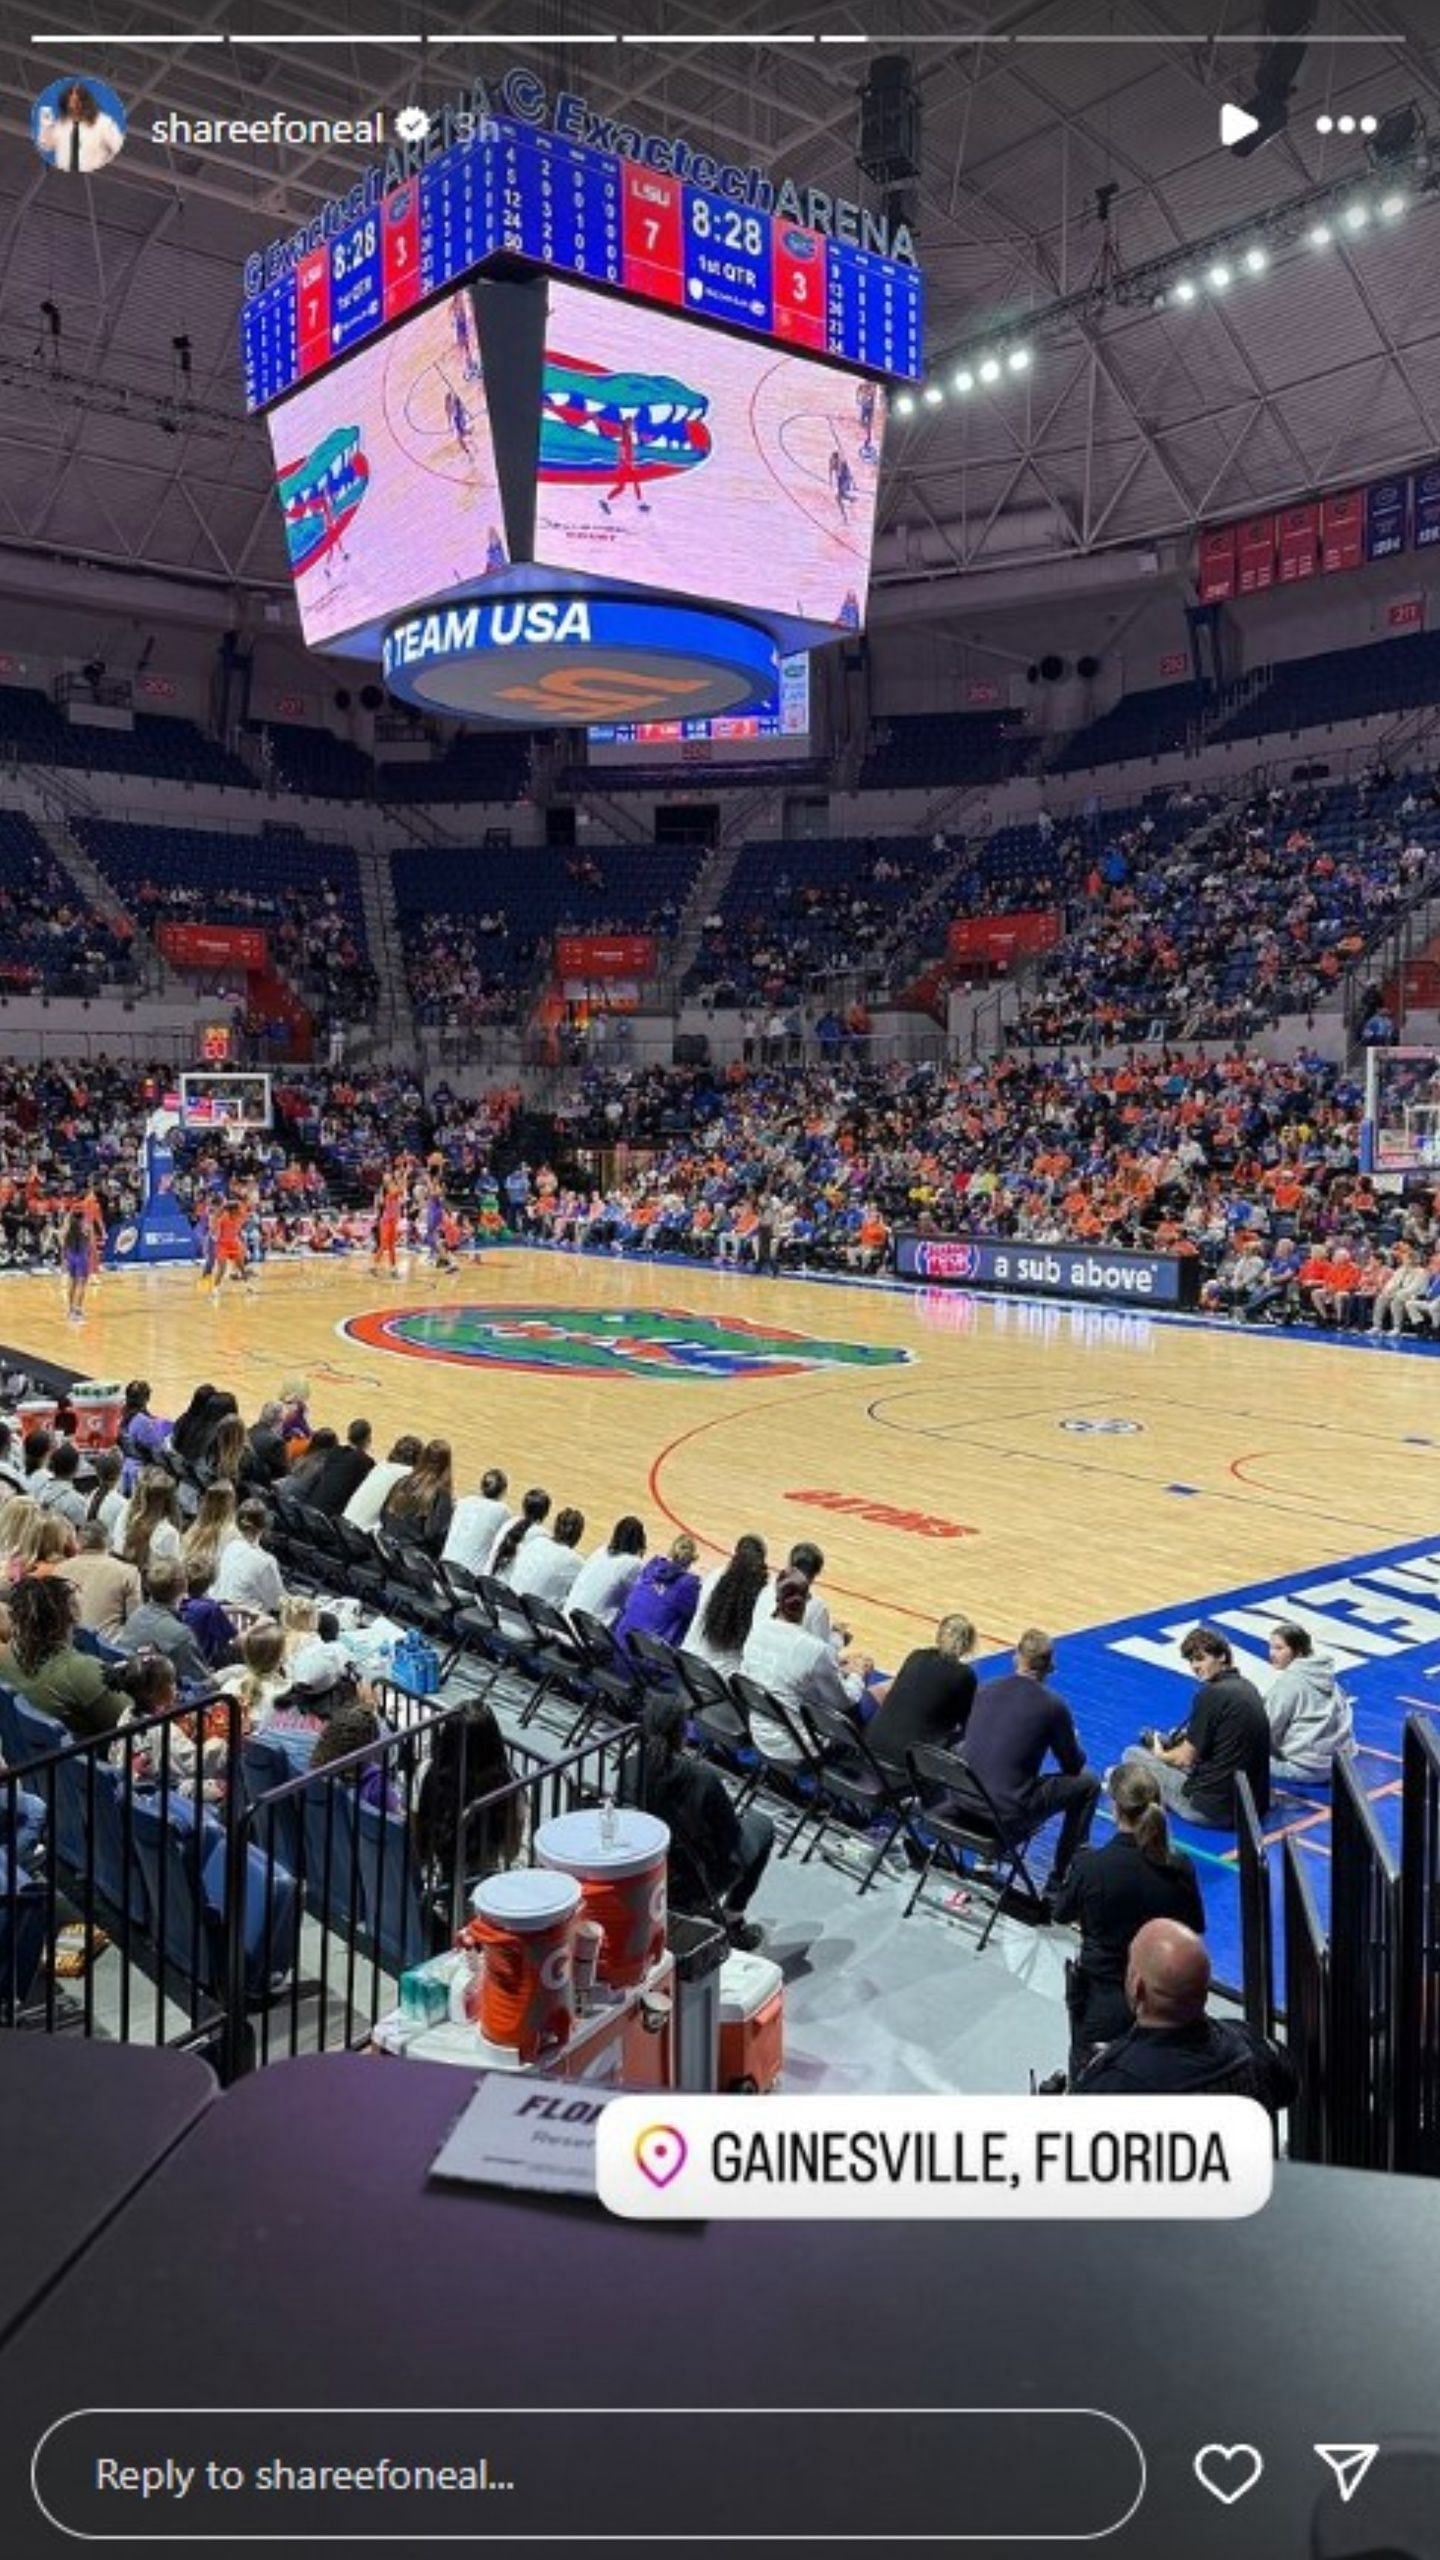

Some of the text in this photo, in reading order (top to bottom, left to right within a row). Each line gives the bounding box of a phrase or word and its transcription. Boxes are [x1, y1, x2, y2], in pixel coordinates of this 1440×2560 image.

[632, 179, 671, 208] LSU
[644, 217, 660, 250] 7
[692, 198, 763, 256] 8:28
[775, 177, 919, 267] ARENA
[333, 221, 376, 281] 8:28
[698, 254, 757, 289] 1st QTR
[792, 271, 807, 301] 3
[308, 300, 318, 328] 7
[394, 607, 481, 667] TEAM
[490, 601, 591, 646] USA
[994, 1256, 1009, 1279] a
[1018, 1256, 1061, 1284] sub
[1071, 1259, 1152, 1293] above
